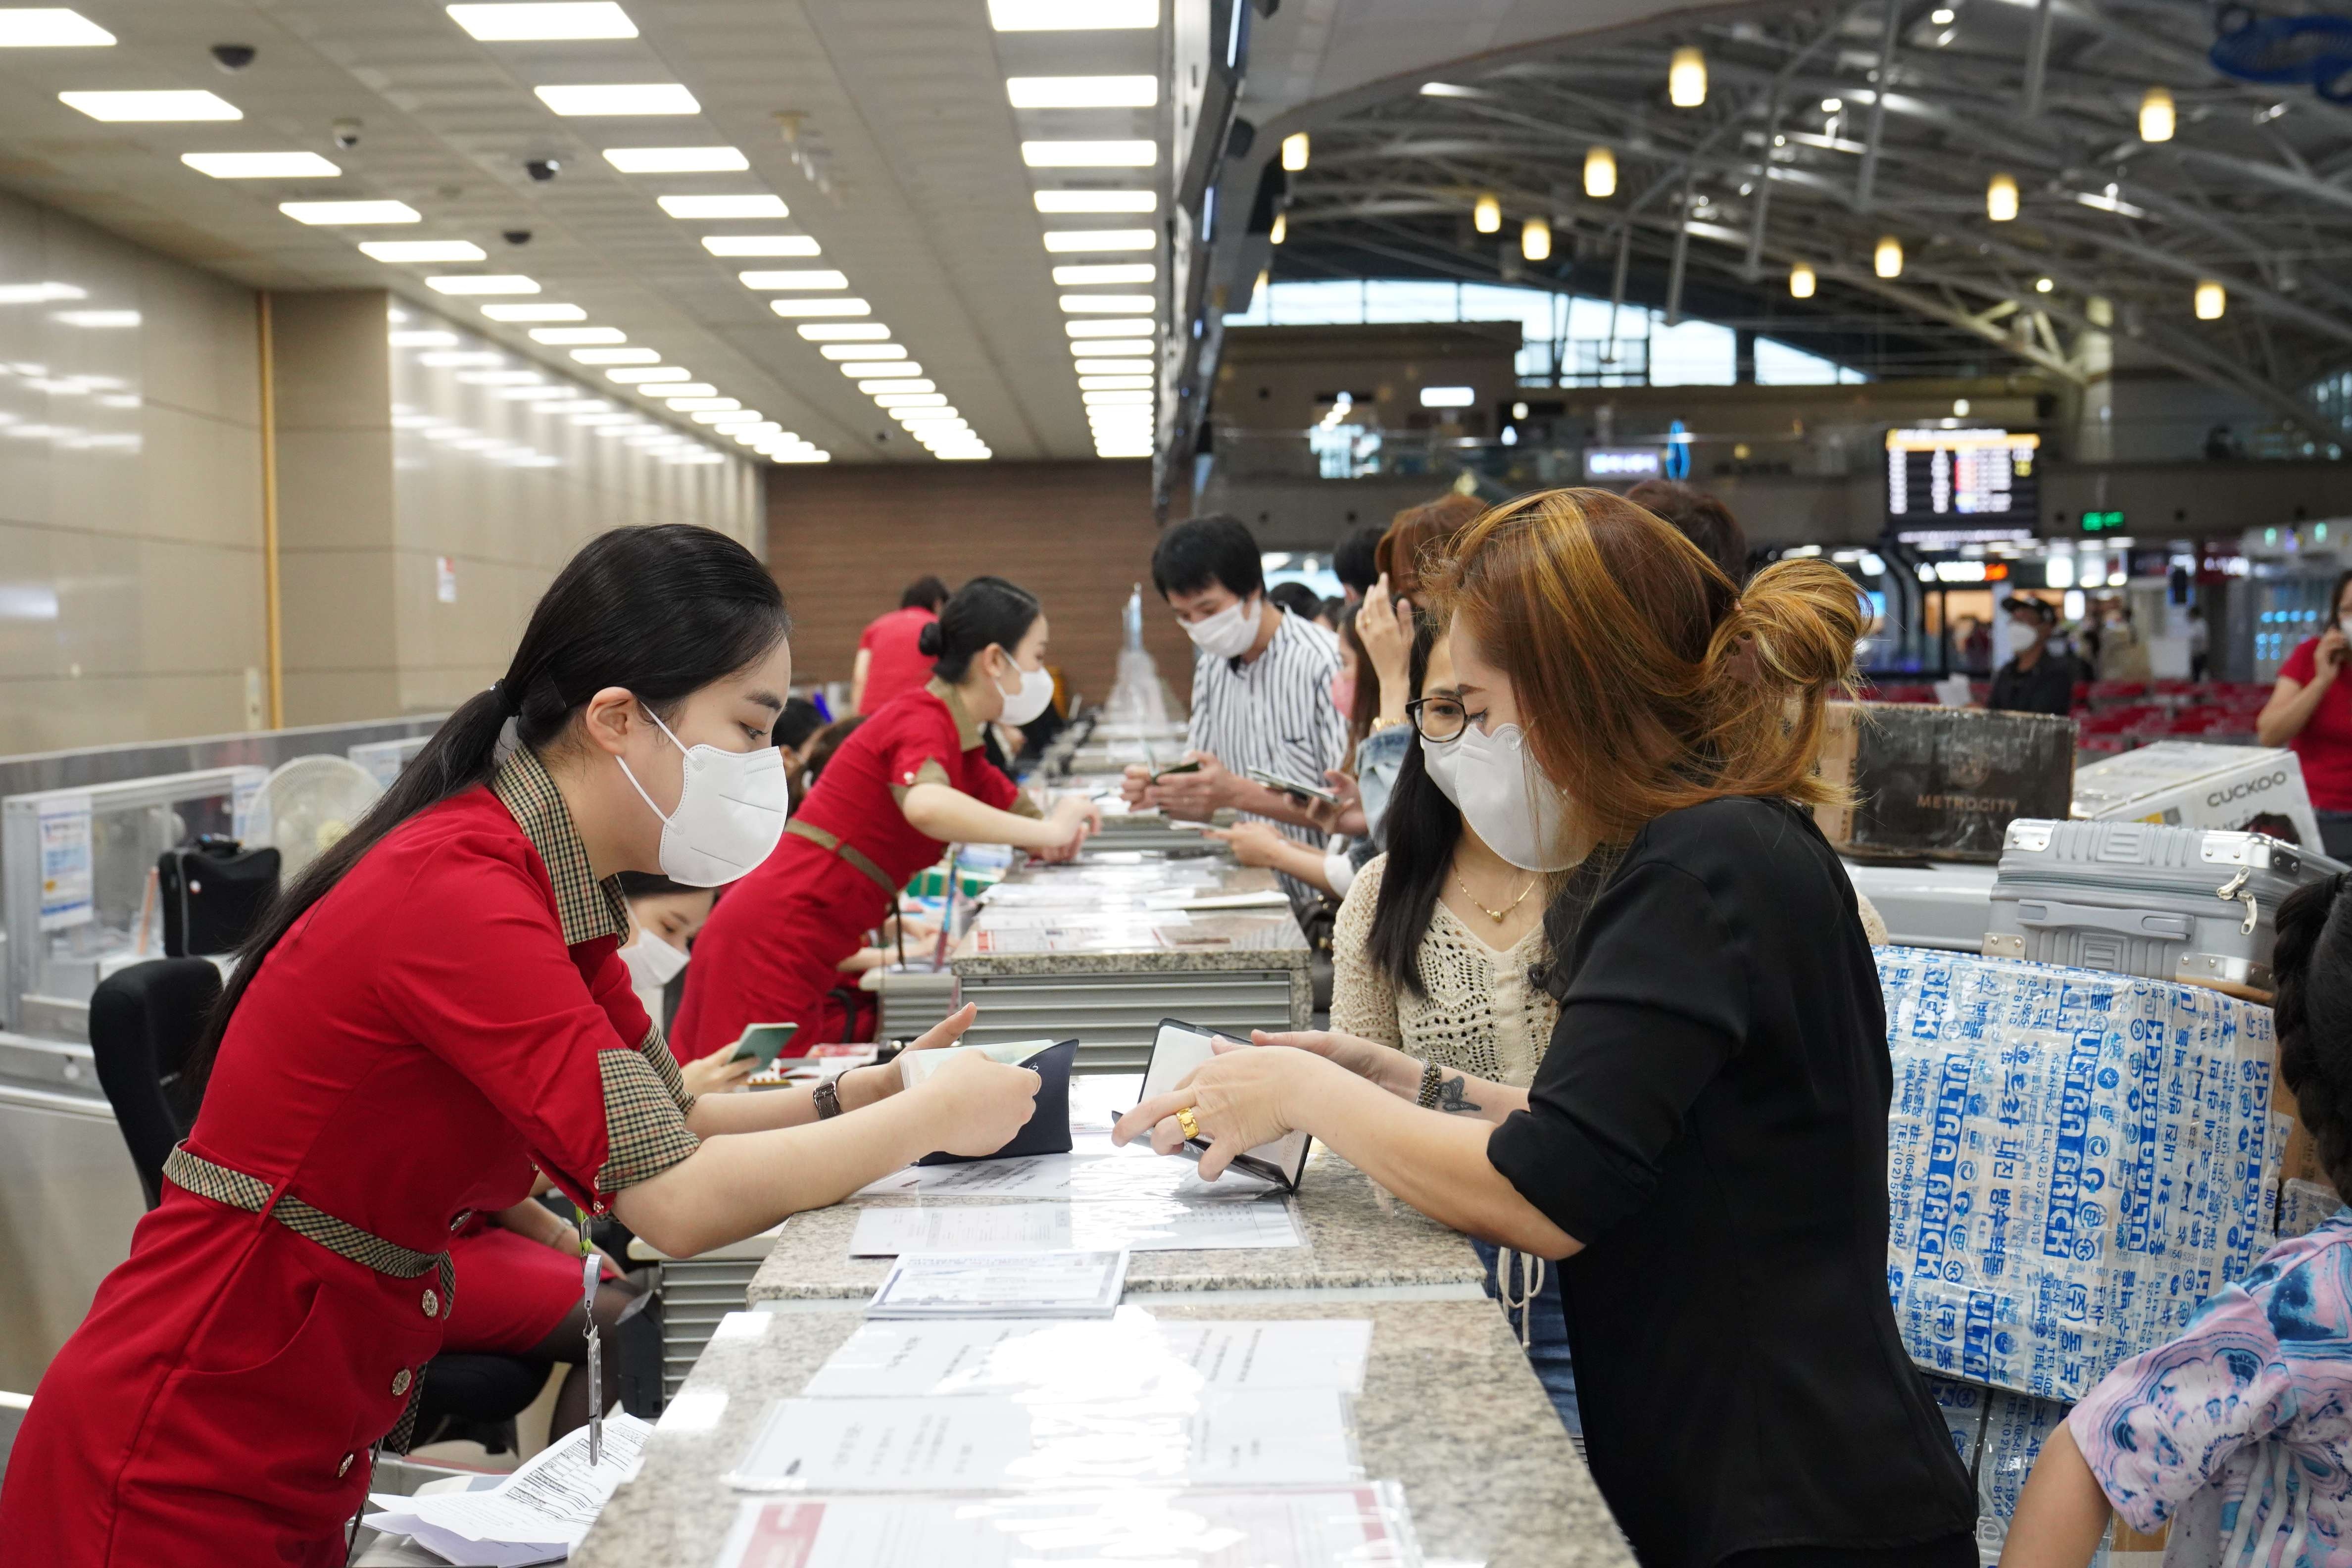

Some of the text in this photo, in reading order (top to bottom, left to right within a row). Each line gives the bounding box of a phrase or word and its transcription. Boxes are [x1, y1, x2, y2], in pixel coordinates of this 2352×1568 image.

[1916, 792, 2018, 812] METROCITY
[2207, 771, 2287, 807] CUCKOO
[2174, 1028, 2189, 1068] 벽돌
[2060, 1031, 2102, 1137] ULTRA
[2168, 1073, 2183, 1115] 방수
[2250, 1061, 2270, 1165] BRICK
[1916, 1055, 1971, 1278] ULTRA BRICK
[1982, 1044, 2031, 1276] 울트라 내진 방수 벽돌
[2129, 1141, 2155, 1250] ULTRA
[2142, 1020, 2163, 1128] BRICK
[2163, 1124, 2178, 1163] 내진
[2045, 1148, 2082, 1258] BRICK
[2149, 1174, 2173, 1261] 울트라
[2064, 1283, 2088, 1322] (주)
[2120, 1270, 2136, 1310] 벽돌
